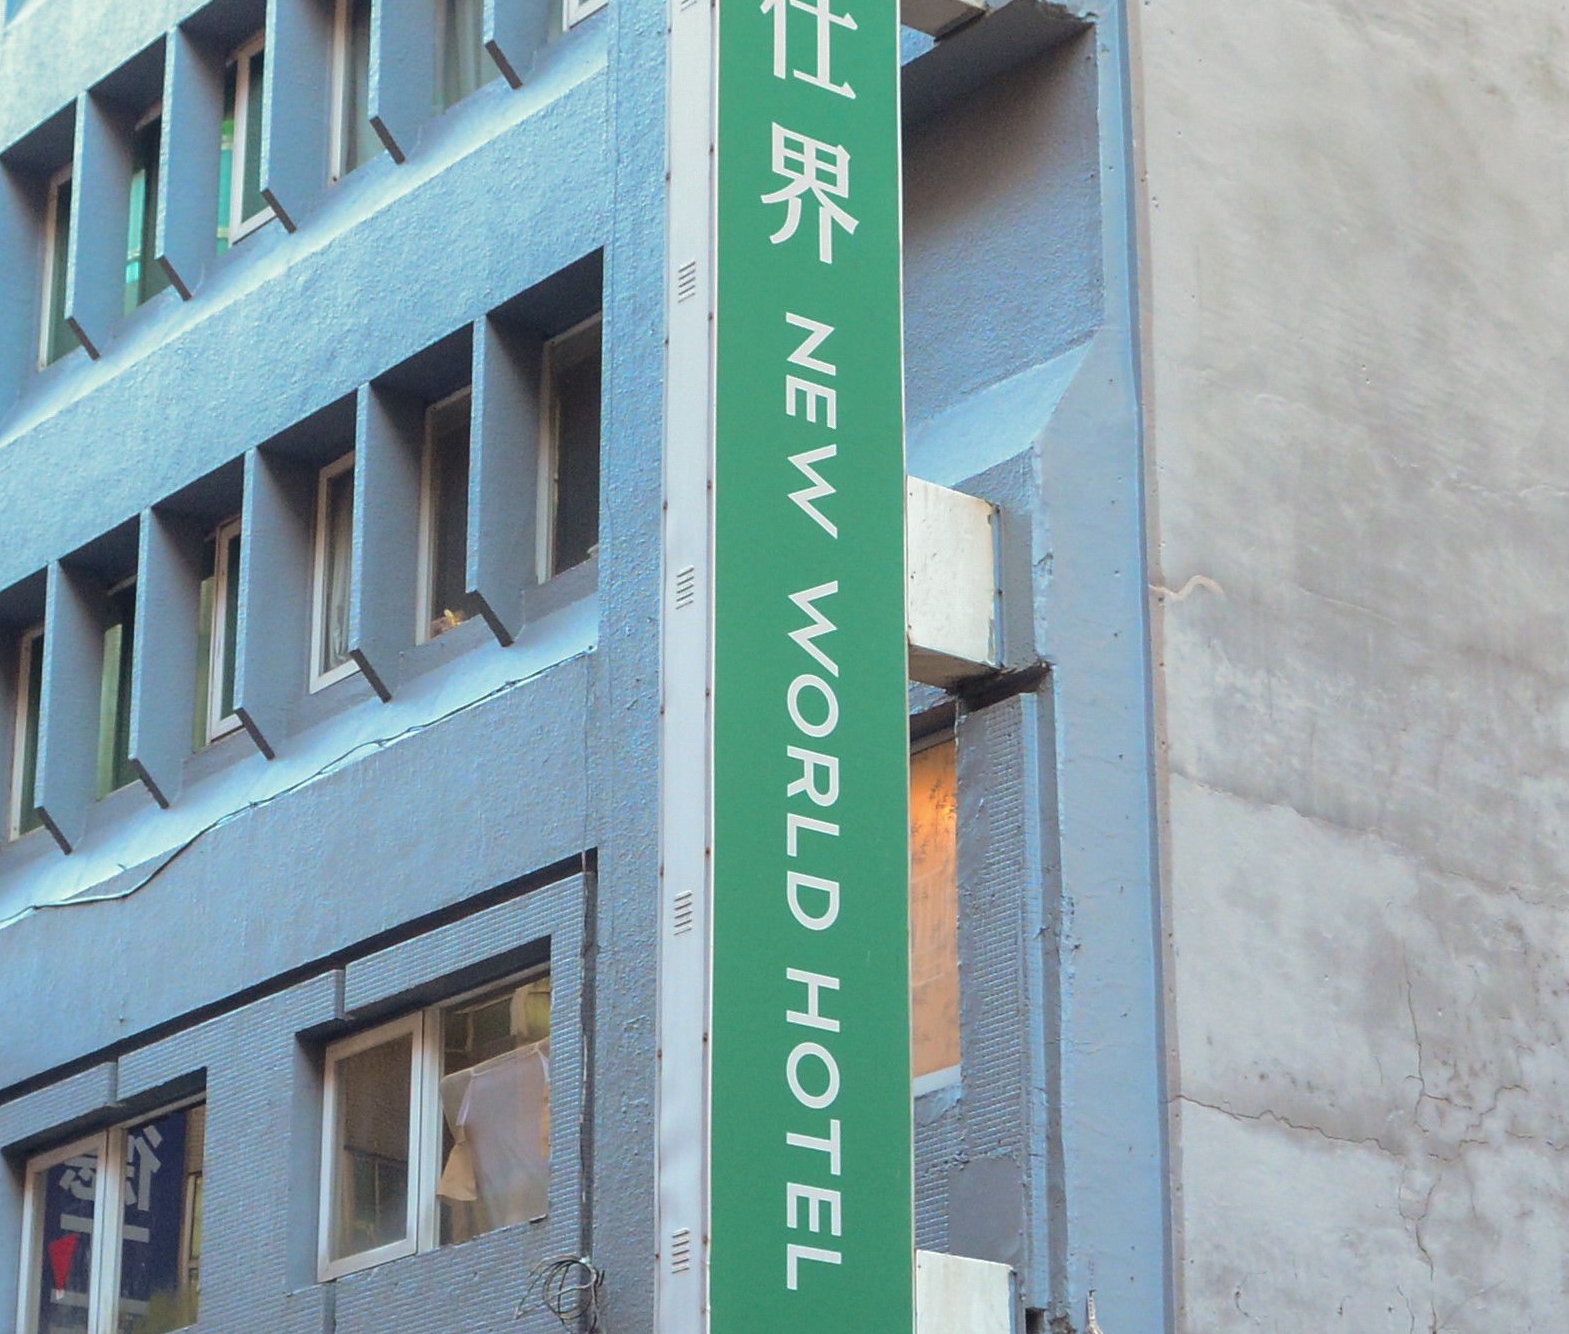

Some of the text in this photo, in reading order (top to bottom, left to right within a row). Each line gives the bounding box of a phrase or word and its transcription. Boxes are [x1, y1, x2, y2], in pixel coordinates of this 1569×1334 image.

[785, 312, 841, 1291] NEW WORLD HOTEL
